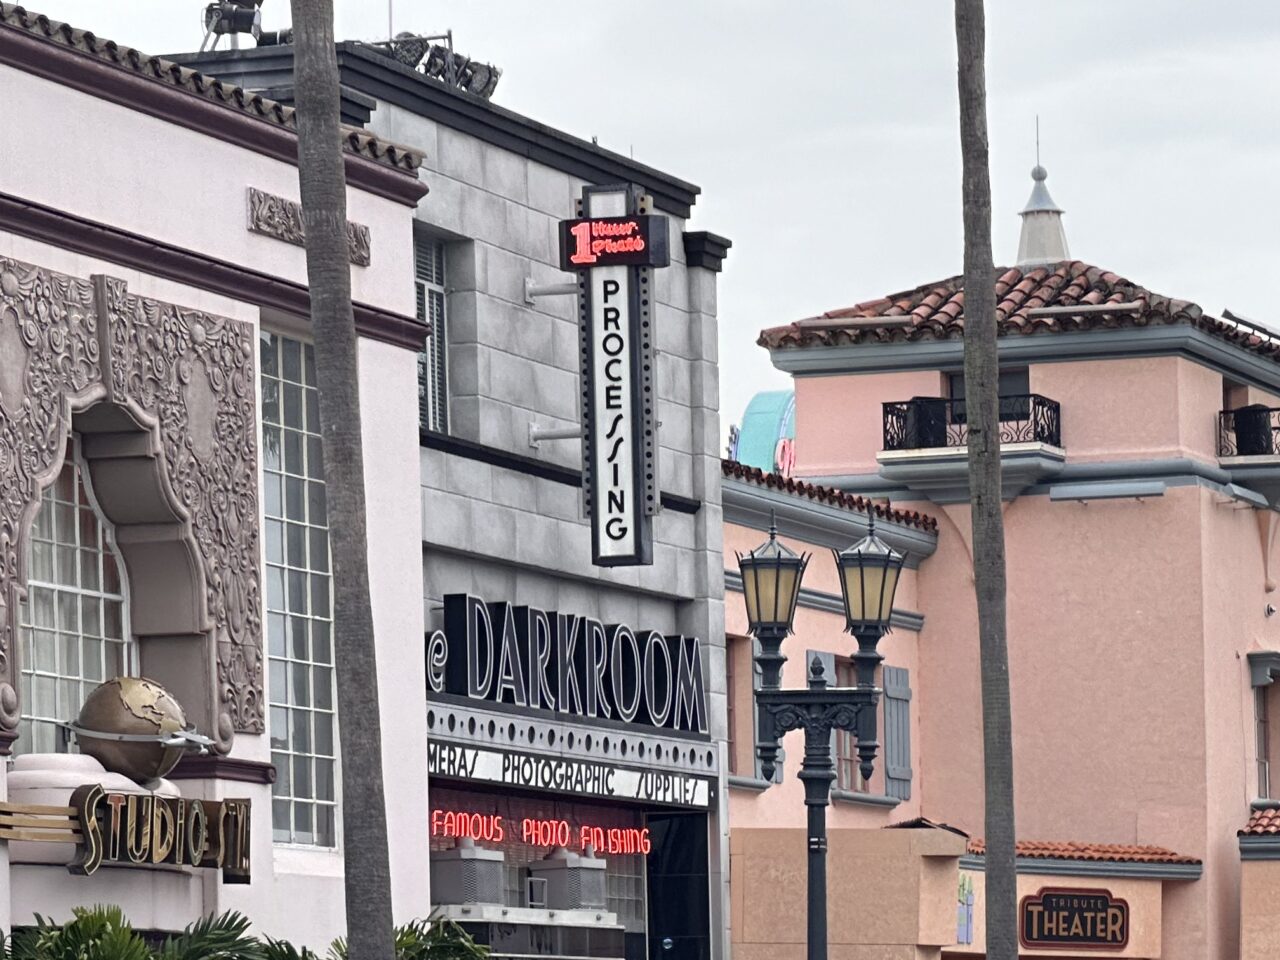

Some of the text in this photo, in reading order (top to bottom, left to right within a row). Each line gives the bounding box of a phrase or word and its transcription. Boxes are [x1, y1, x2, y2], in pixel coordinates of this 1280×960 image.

[570, 222, 597, 264] 1
[602, 280, 628, 541] PROCESSING
[465, 594, 709, 734] DARKROOM
[502, 753, 616, 796] PHOTOGRAPHIC
[634, 772, 698, 805] SUPPLIES
[84, 783, 206, 876] STUDIO
[432, 810, 504, 842] FAMOUS
[522, 818, 570, 847] PHOTO
[1027, 905, 1124, 941] THEATER
[1051, 897, 1105, 909] TRIBUTE
